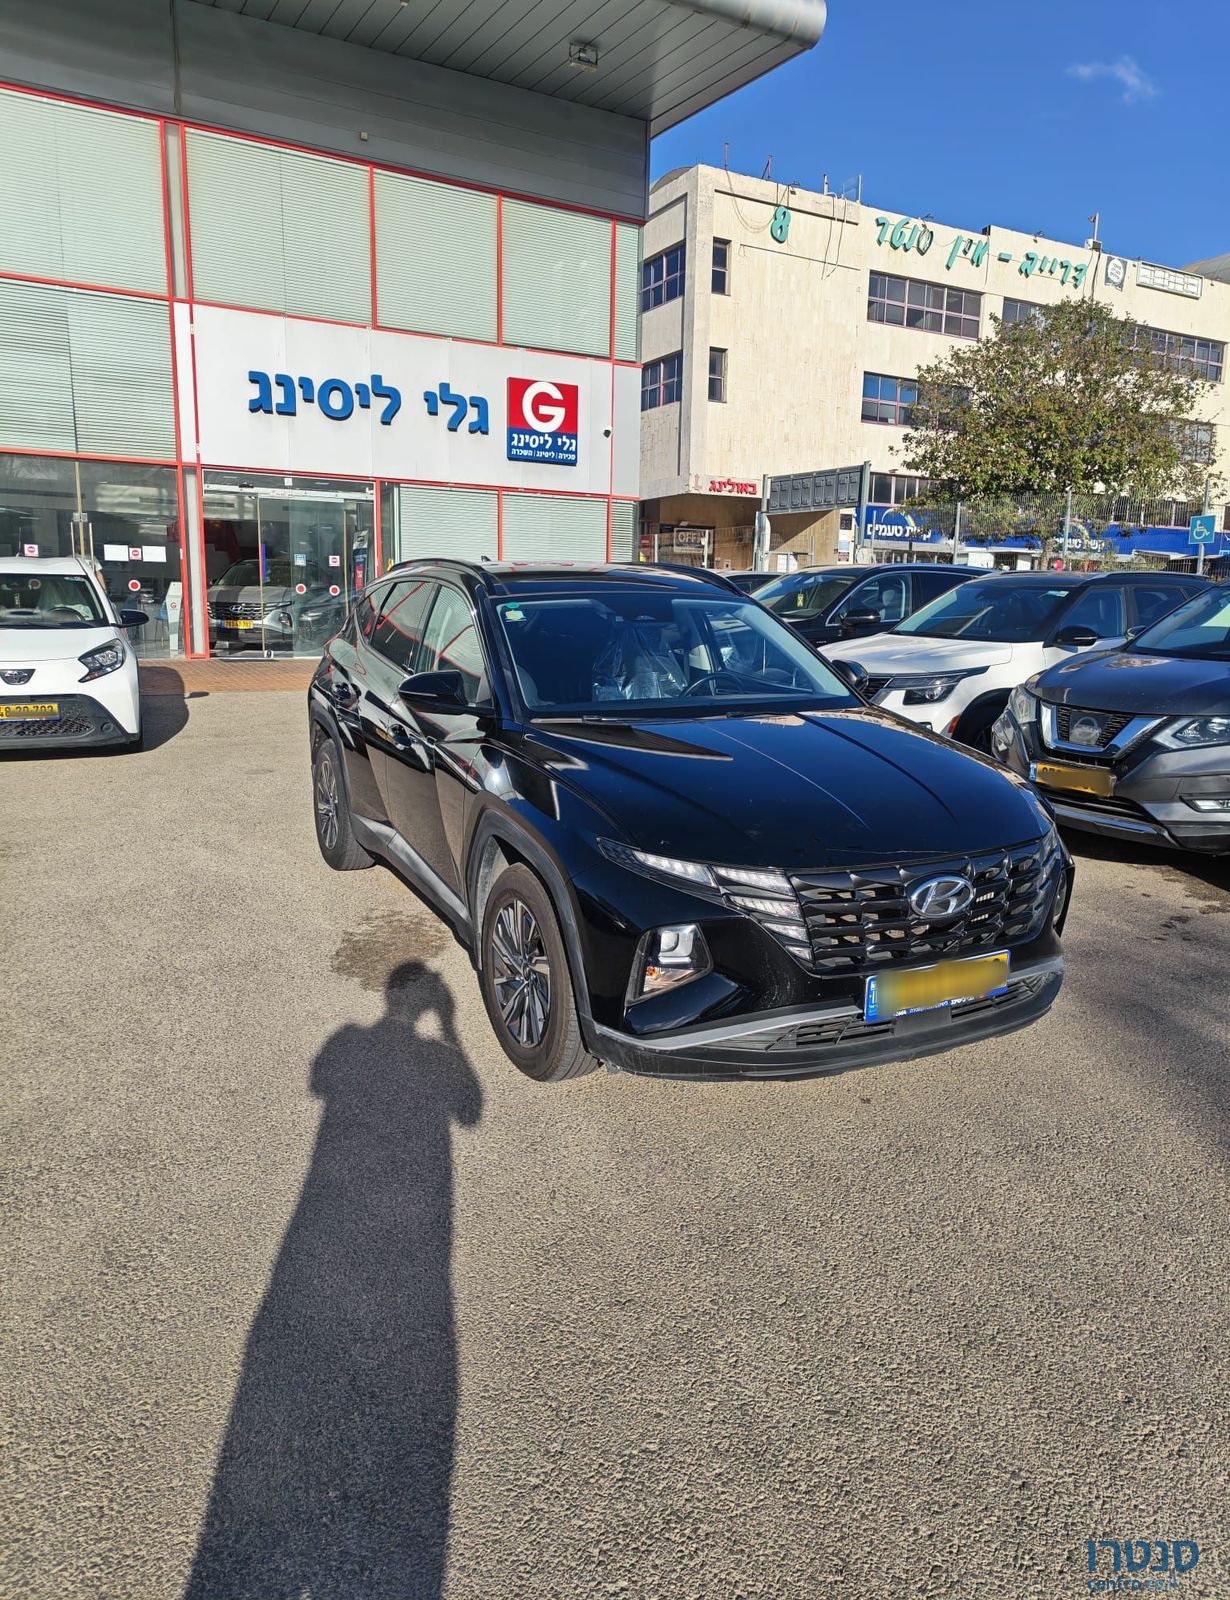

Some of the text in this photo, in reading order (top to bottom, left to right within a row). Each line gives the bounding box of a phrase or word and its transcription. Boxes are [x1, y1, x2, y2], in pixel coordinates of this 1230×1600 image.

[770, 205, 791, 243] 8
[875, 216, 934, 256] סנטר
[945, 235, 990, 271] אין
[248, 370, 489, 435] גלי ליסינג
[522, 381, 566, 433] G
[511, 433, 577, 451] גלי ליסינג
[709, 478, 757, 495] באולינג
